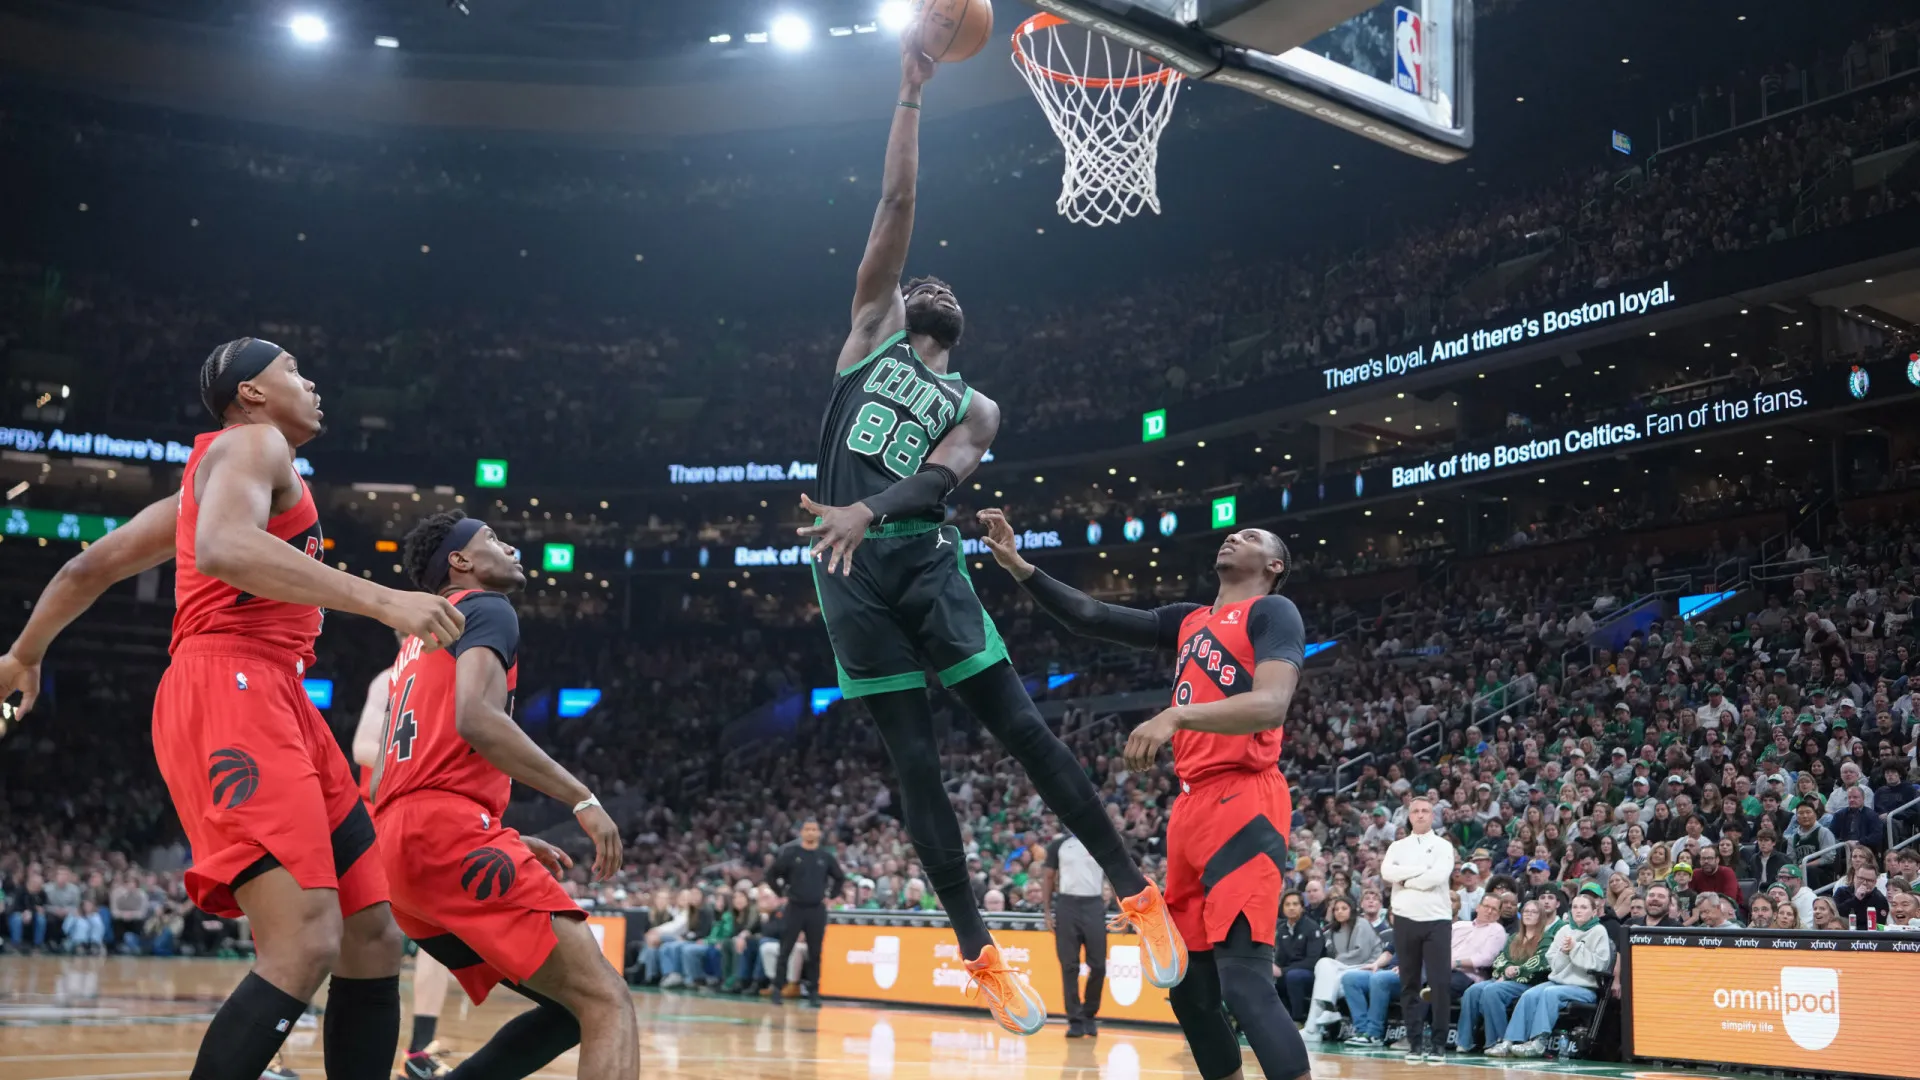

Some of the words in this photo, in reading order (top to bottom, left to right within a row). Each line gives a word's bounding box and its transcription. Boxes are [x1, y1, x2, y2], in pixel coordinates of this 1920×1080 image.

[1323, 358, 1383, 390] There's
[1386, 345, 1427, 375] loyal.
[1431, 333, 1468, 362] And
[1472, 318, 1539, 352] there's
[1543, 300, 1615, 333] Boston
[1620, 281, 1675, 314] loyal.
[863, 357, 955, 440] CELTICS
[1145, 416, 1163, 435] TD
[48, 429, 92, 454] And
[846, 401, 930, 478] 88
[1392, 461, 1436, 488] Bank
[1439, 455, 1458, 478] of
[1460, 452, 1491, 473] the
[1494, 439, 1560, 467] Boston
[1564, 422, 1641, 453] Celtics.
[1646, 413, 1683, 436] Fan
[1688, 404, 1708, 426] of
[1713, 400, 1749, 422] the
[1753, 389, 1808, 415] fans.
[481, 463, 505, 482] TD
[668, 464, 716, 484] There
[1215, 502, 1234, 522] TD
[1024, 530, 1062, 549] fans.
[548, 547, 571, 567] TD
[735, 546, 779, 566] Bank
[780, 545, 800, 565] of
[1630, 935, 1651, 945] xfinity
[1664, 936, 1686, 946] xfinity
[1699, 937, 1722, 946] xfinity
[1735, 937, 1759, 948] xfinity
[1772, 939, 1797, 950] xfinity
[1811, 940, 1836, 951] xfinity
[1851, 940, 1878, 951] xfinity
[1713, 985, 1836, 1015] omnipod
[1721, 1020, 1757, 1033] simplify
[1759, 1021, 1774, 1032] life
